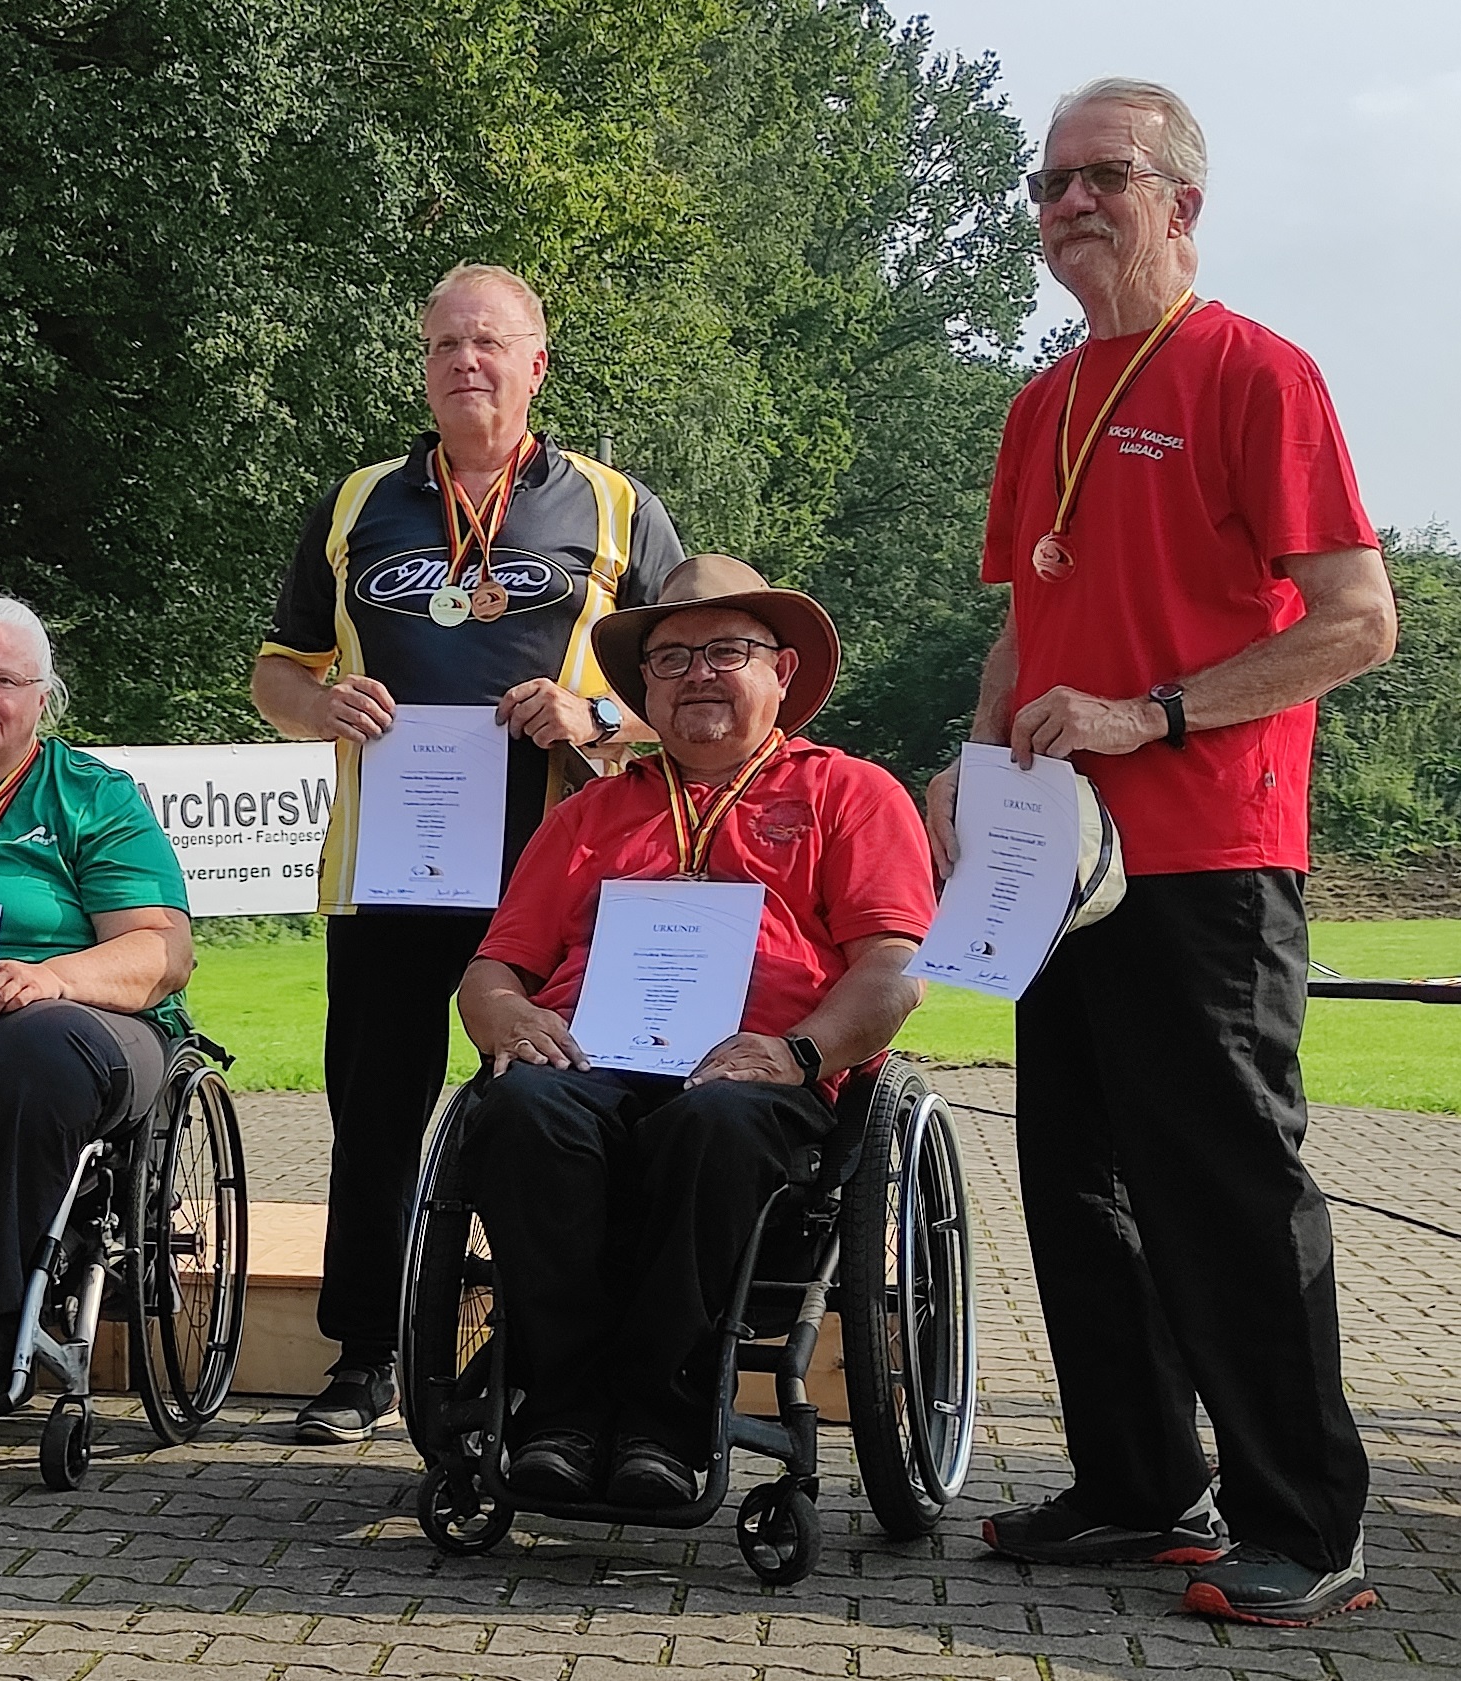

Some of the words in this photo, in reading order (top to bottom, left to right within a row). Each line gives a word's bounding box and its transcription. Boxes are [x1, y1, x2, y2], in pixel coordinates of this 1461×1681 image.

[1119, 441, 1164, 460] HARALD
[369, 558, 552, 602] Mthws
[412, 744, 457, 754] URKUNDE
[1003, 798, 1043, 814] URKUNDE
[164, 828, 243, 849] ogensport
[181, 866, 271, 882] verungen
[282, 863, 319, 878] 056
[652, 924, 702, 934] URKUNDE
